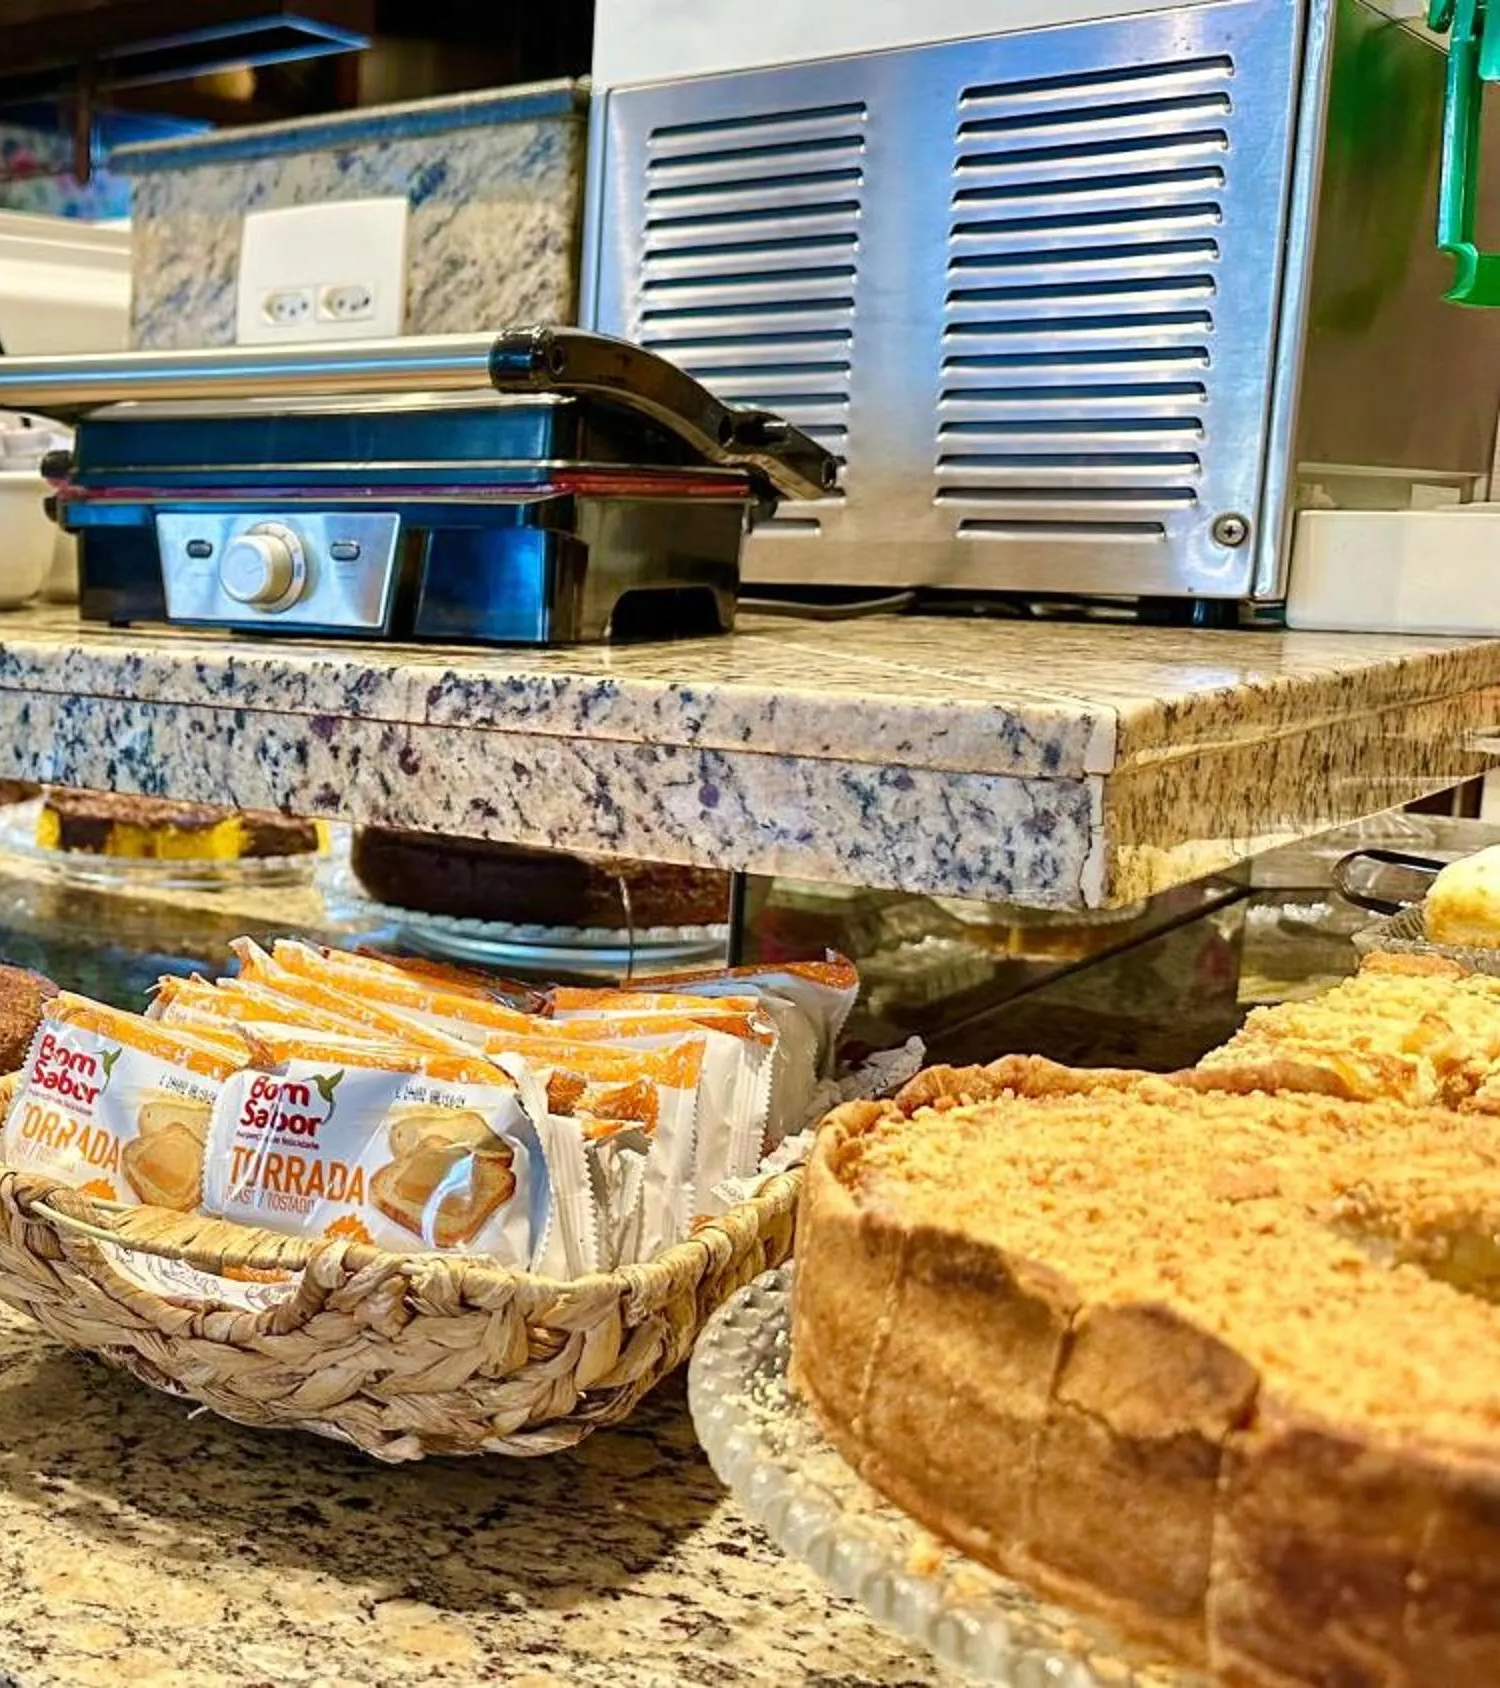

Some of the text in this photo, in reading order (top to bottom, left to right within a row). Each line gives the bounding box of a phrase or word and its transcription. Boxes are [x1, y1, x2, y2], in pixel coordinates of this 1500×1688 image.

[39, 1033, 97, 1078] Bom
[30, 1059, 100, 1105] Sabor
[250, 1075, 311, 1107] Bom
[240, 1099, 322, 1137] Sabor
